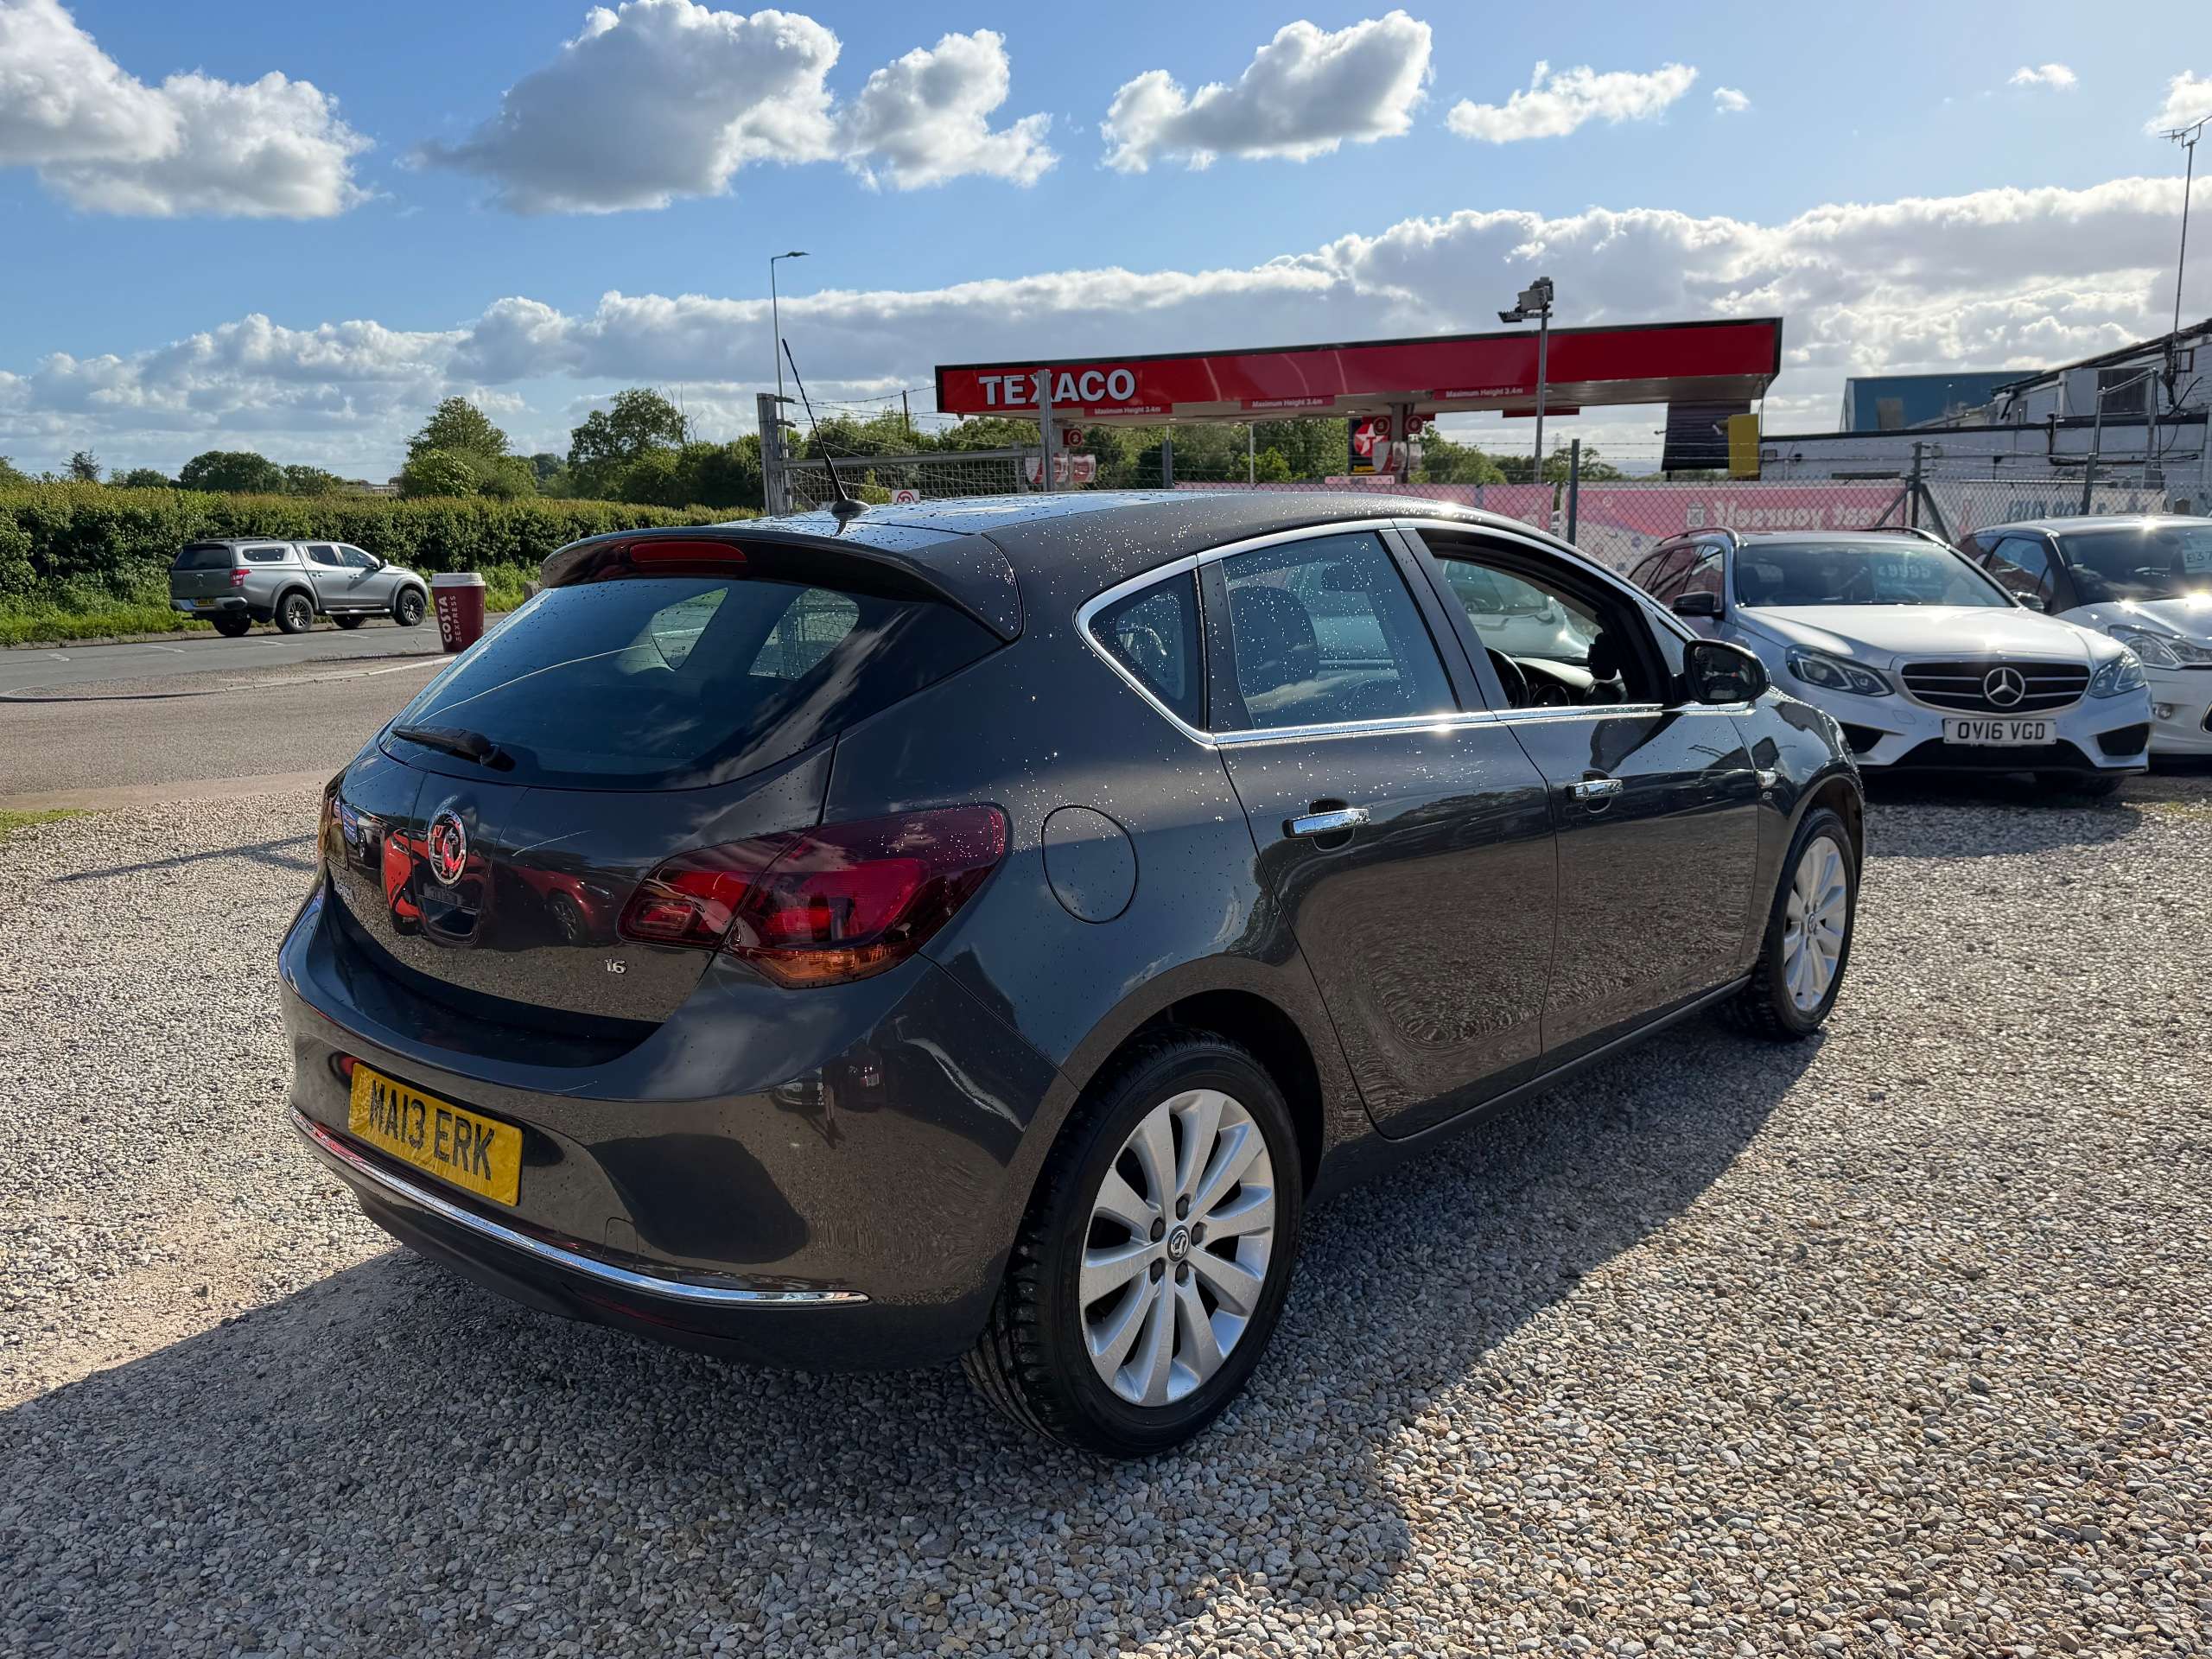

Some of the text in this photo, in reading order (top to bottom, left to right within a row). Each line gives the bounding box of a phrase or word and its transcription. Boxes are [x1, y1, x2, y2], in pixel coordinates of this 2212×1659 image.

[1284, 398, 1305, 407] Height
[438, 595, 453, 643] COSTA
[450, 595, 461, 636] EXPRESS
[1957, 721, 2045, 740] OV16 VGD
[434, 1108, 495, 1181] ERK
